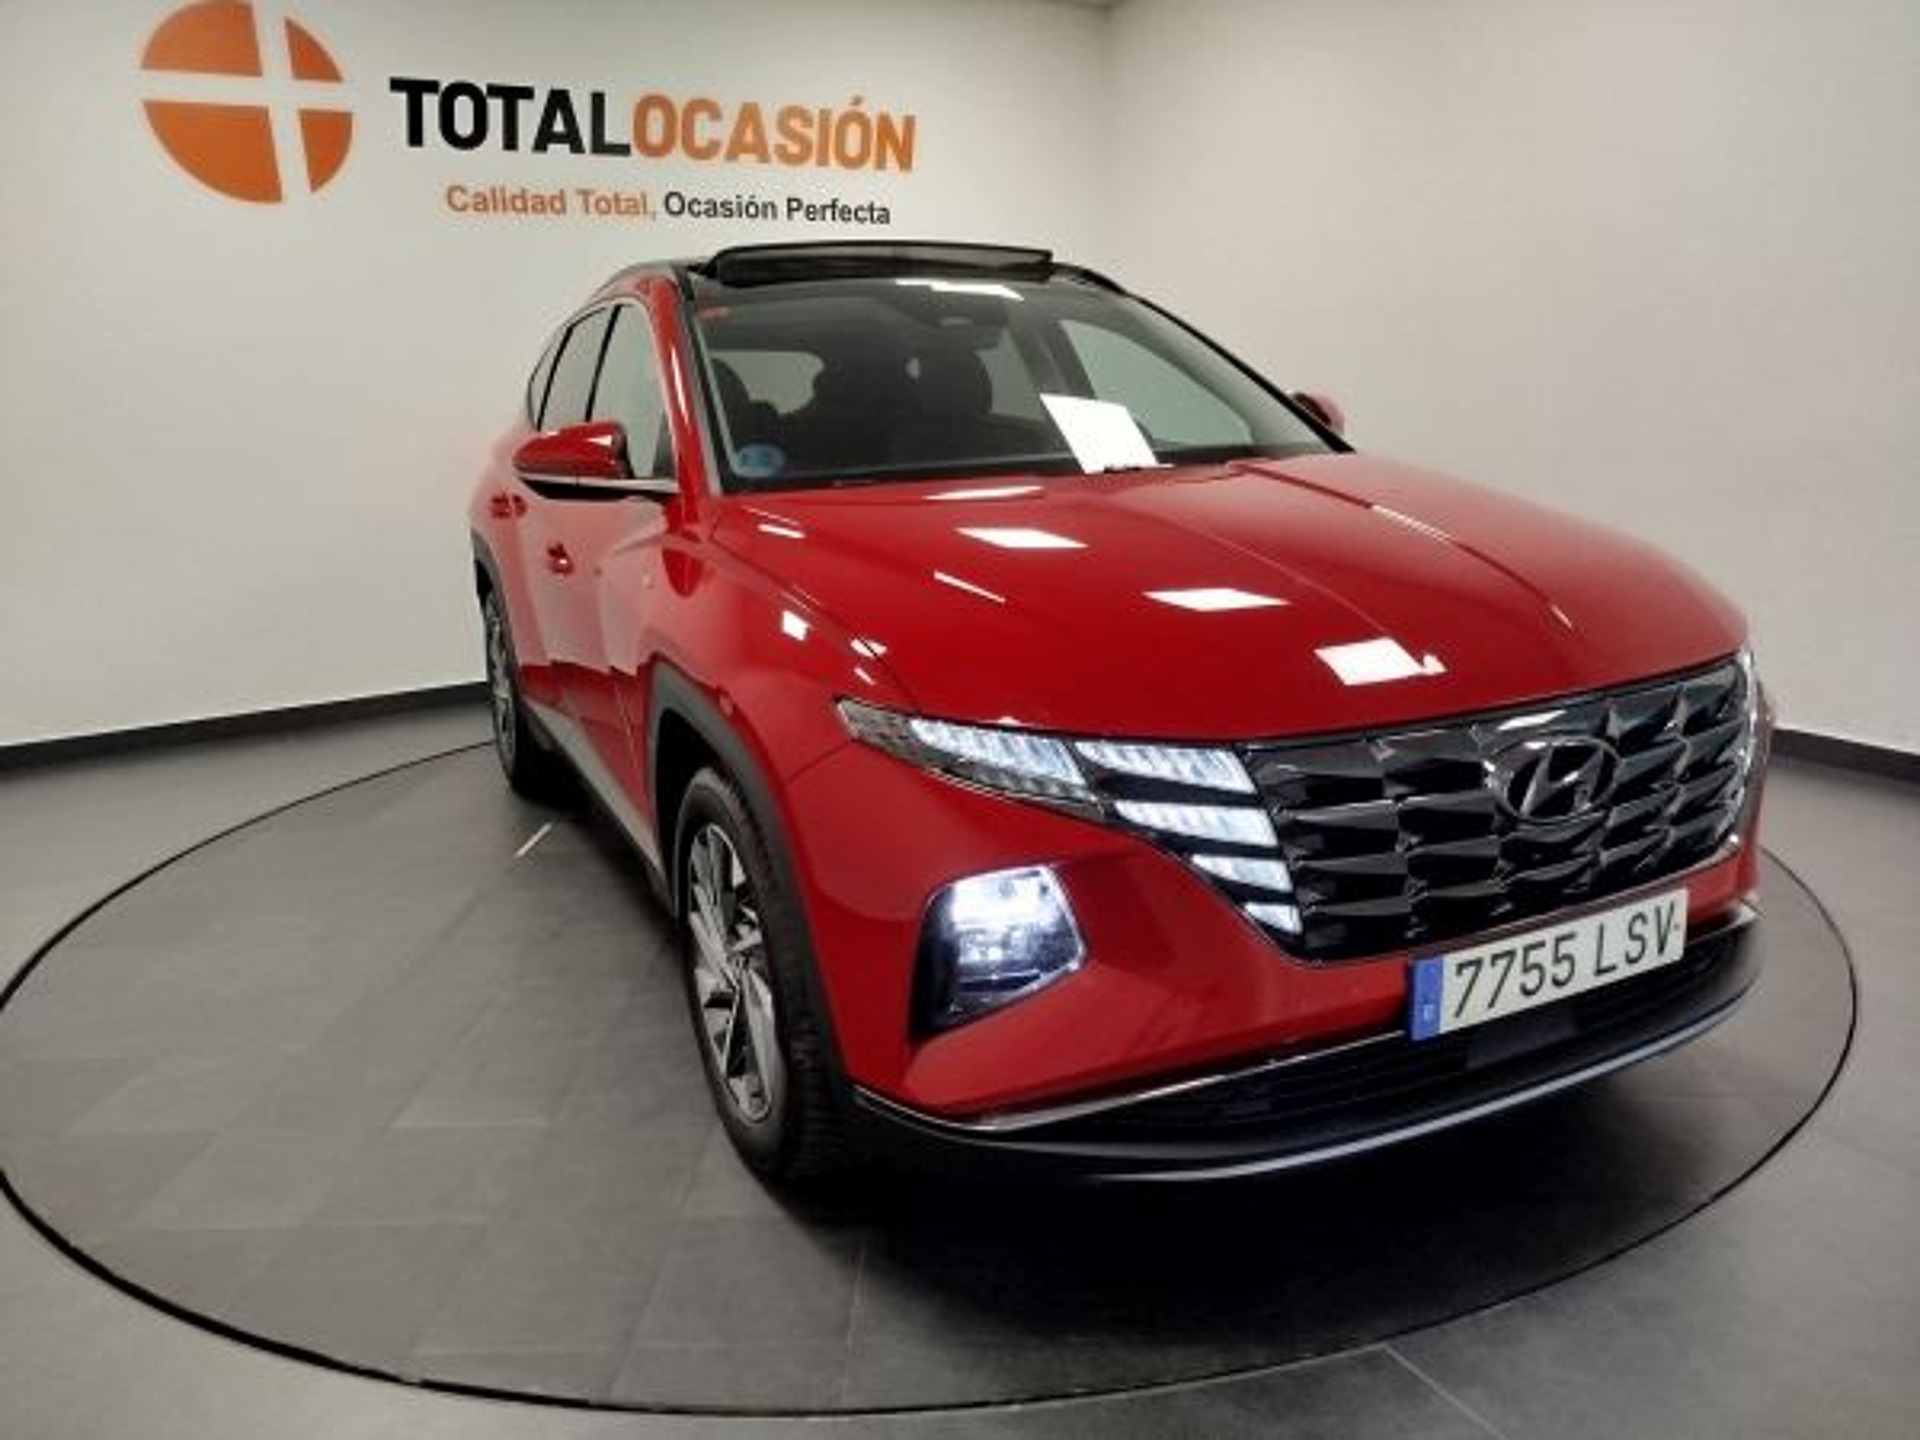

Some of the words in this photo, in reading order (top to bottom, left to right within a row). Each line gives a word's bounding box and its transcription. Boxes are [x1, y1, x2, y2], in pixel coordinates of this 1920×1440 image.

[446, 184, 568, 216] Calidad
[577, 188, 658, 221] Total,
[663, 191, 779, 222] Ocasión
[786, 196, 892, 226] Perfecta
[1454, 930, 1578, 1020] 7755
[1593, 900, 1676, 978] LSV
